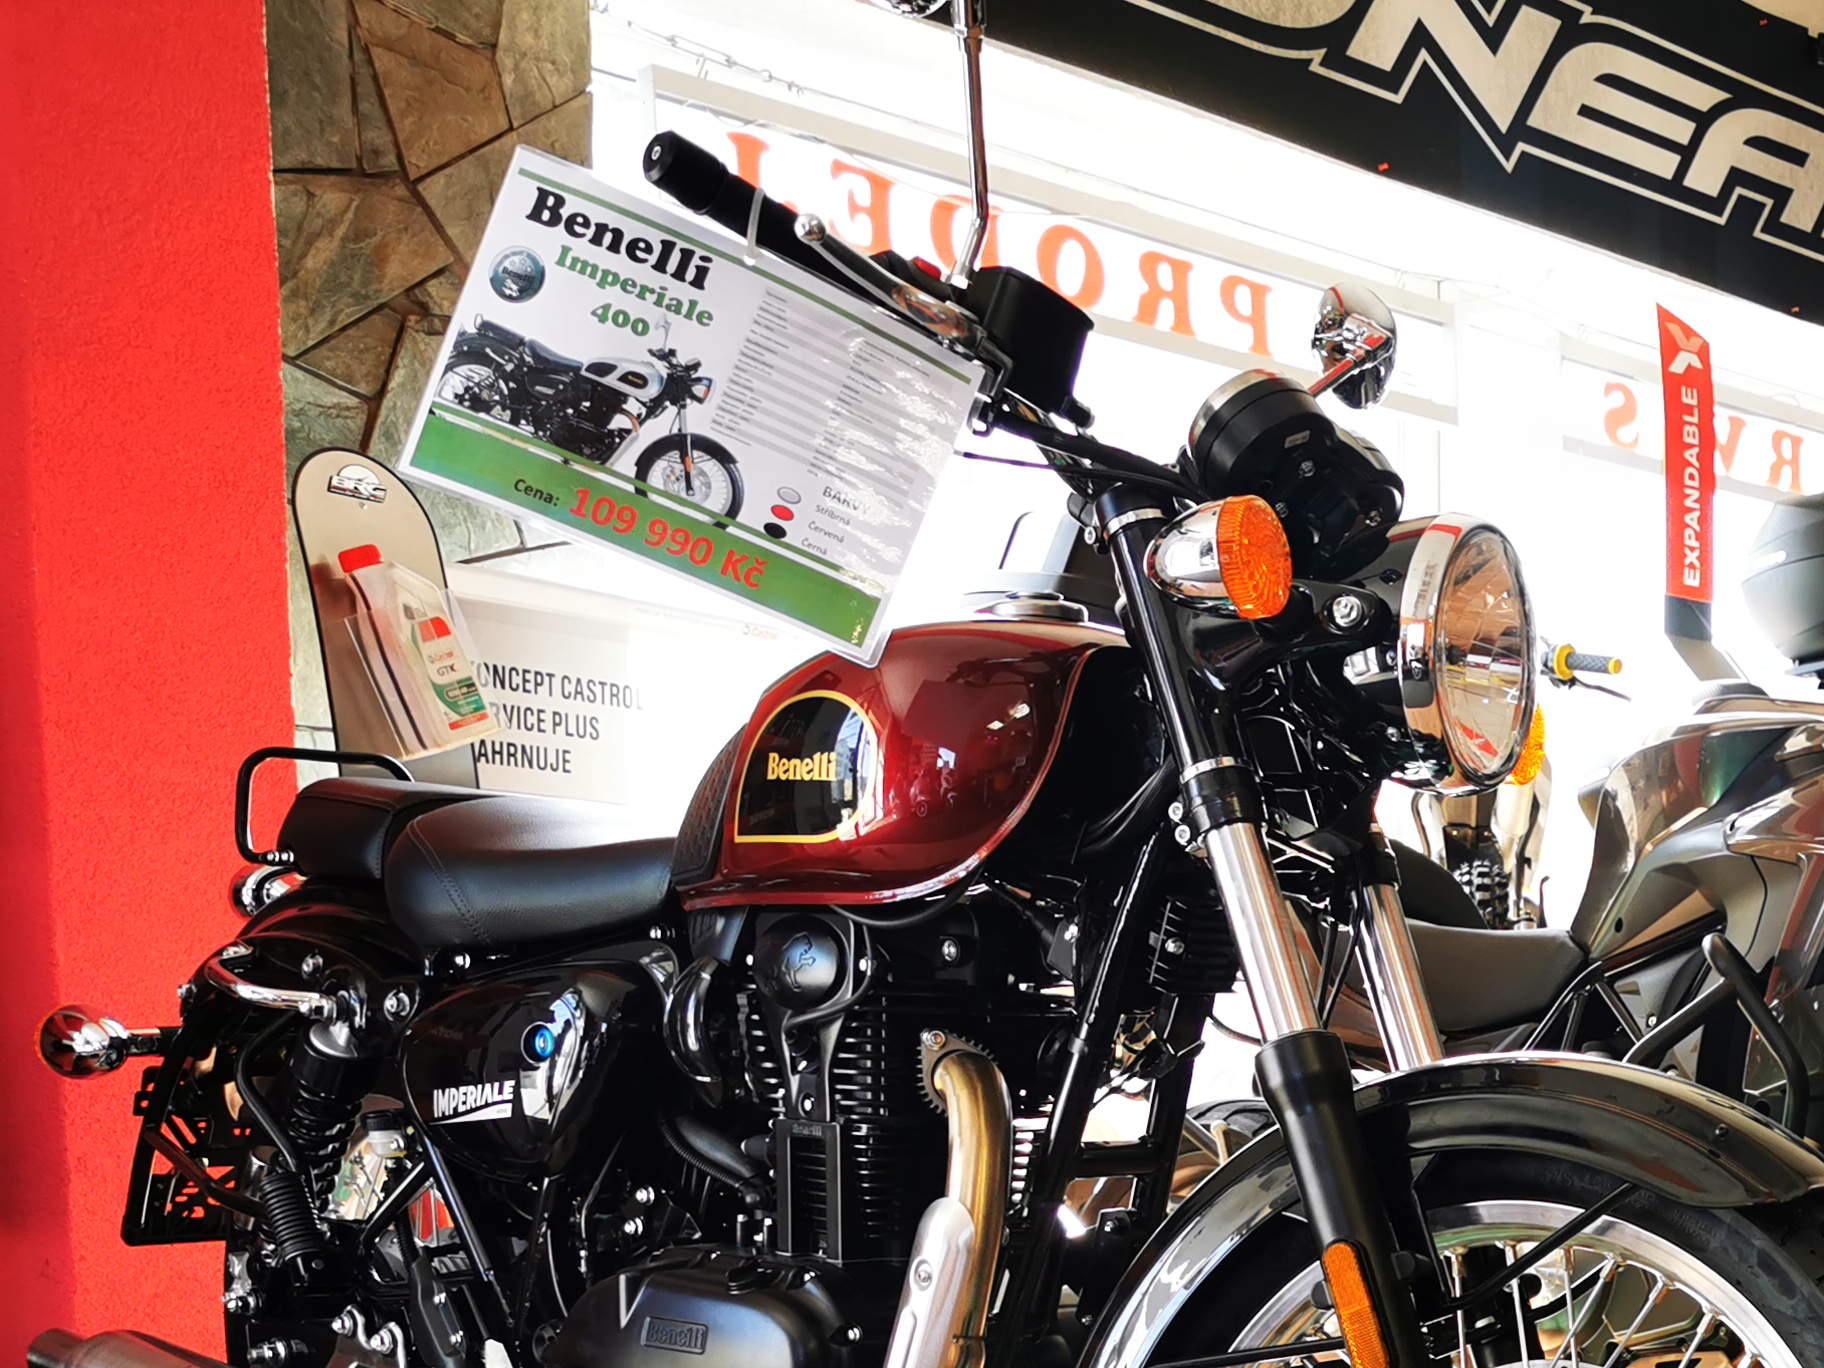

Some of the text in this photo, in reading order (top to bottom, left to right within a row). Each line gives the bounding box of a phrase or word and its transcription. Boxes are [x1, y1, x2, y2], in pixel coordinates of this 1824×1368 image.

[525, 186, 713, 290] Benelli
[555, 244, 714, 327] Imperiale
[590, 302, 650, 337] 400
[1681, 384, 1701, 588] EXPANDABLE
[513, 477, 768, 589] Cena: 109 990 Kč
[801, 537, 827, 555] Černá
[808, 520, 845, 543] Červená
[474, 661, 645, 711] ONCEPT CASTROL
[488, 702, 547, 734] RVICE
[552, 711, 600, 741] PLUS
[476, 738, 572, 774] AHRNUJE
[767, 751, 837, 781] Benelli
[433, 1080, 515, 1118] IMPERIALE
[648, 1322, 706, 1350] Benelli
